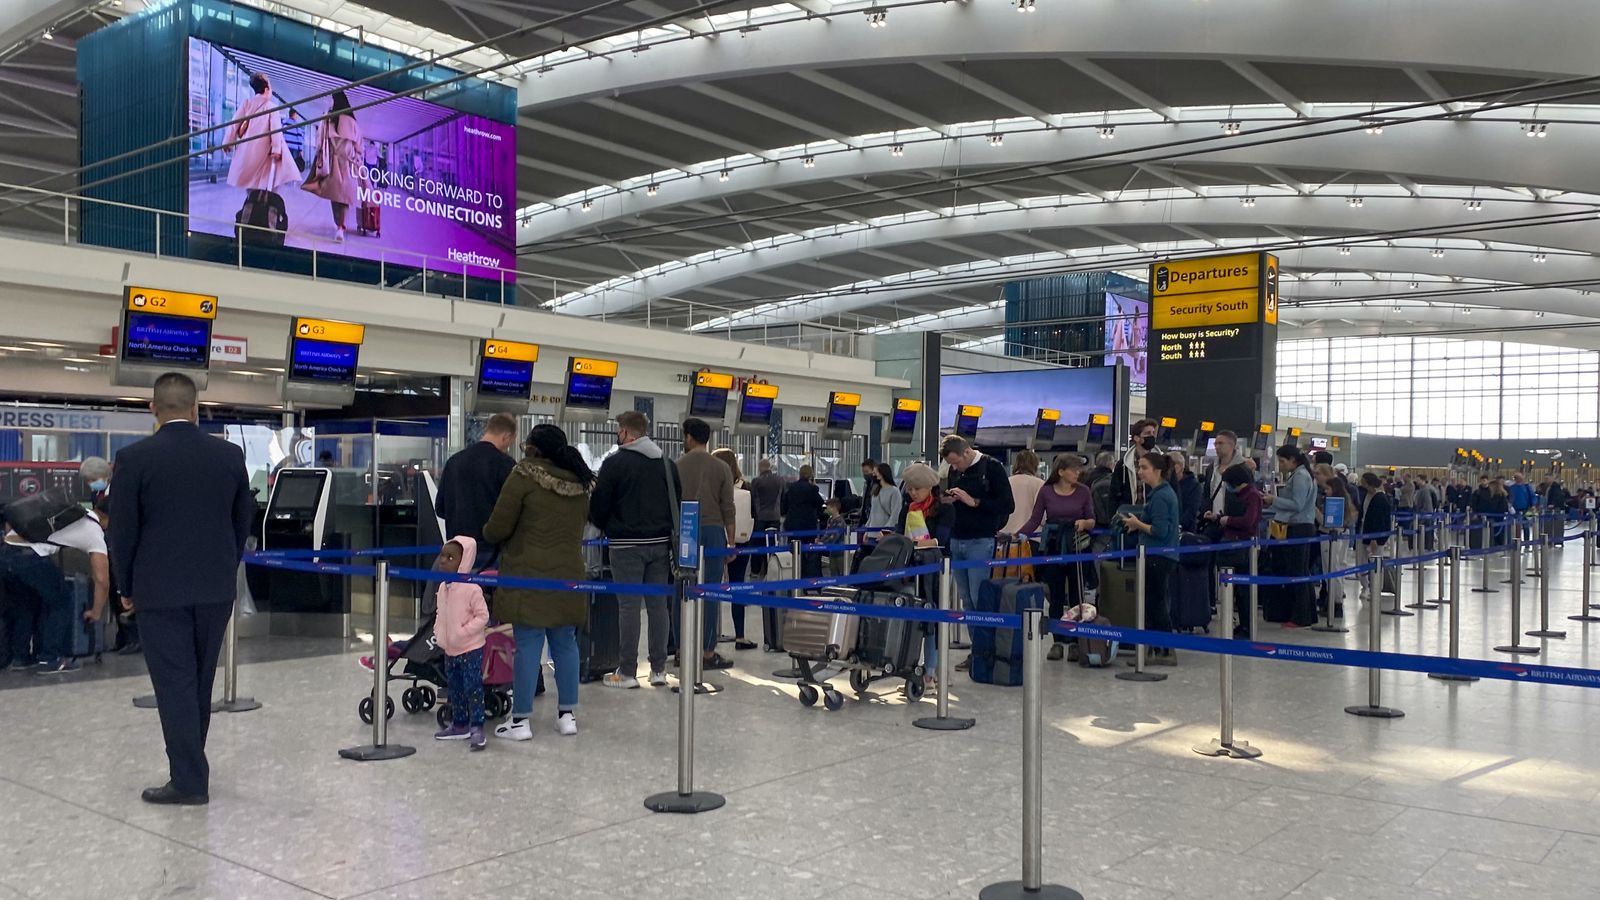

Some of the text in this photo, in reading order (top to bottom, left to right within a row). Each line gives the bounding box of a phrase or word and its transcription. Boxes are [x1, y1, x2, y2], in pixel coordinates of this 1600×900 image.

[464, 125, 502, 141] heathrow.com
[351, 163, 503, 209] LOOKING FORWARD TO
[356, 186, 503, 229] MORE CONNECTIONS
[447, 247, 500, 268] Heathrow
[1170, 266, 1248, 284] Departures
[150, 296, 166, 307] G2
[1170, 300, 1248, 316] Security South
[136, 326, 189, 337] BRITISH AIRWAYS
[312, 325, 325, 334] G3
[1179, 331, 1197, 340] busy
[1198, 330, 1204, 338] is
[1205, 328, 1240, 338] Security?
[128, 342, 198, 353] North America Check-in
[497, 345, 508, 354] G4
[1161, 343, 1182, 351] North
[1161, 351, 1182, 360] South
[1077, 626, 1122, 638] BRITISH AIRWAYS
[1278, 648, 1334, 660] BRITISH AIRWAYS
[1530, 669, 1600, 682] BRITISH AIRWAYS
